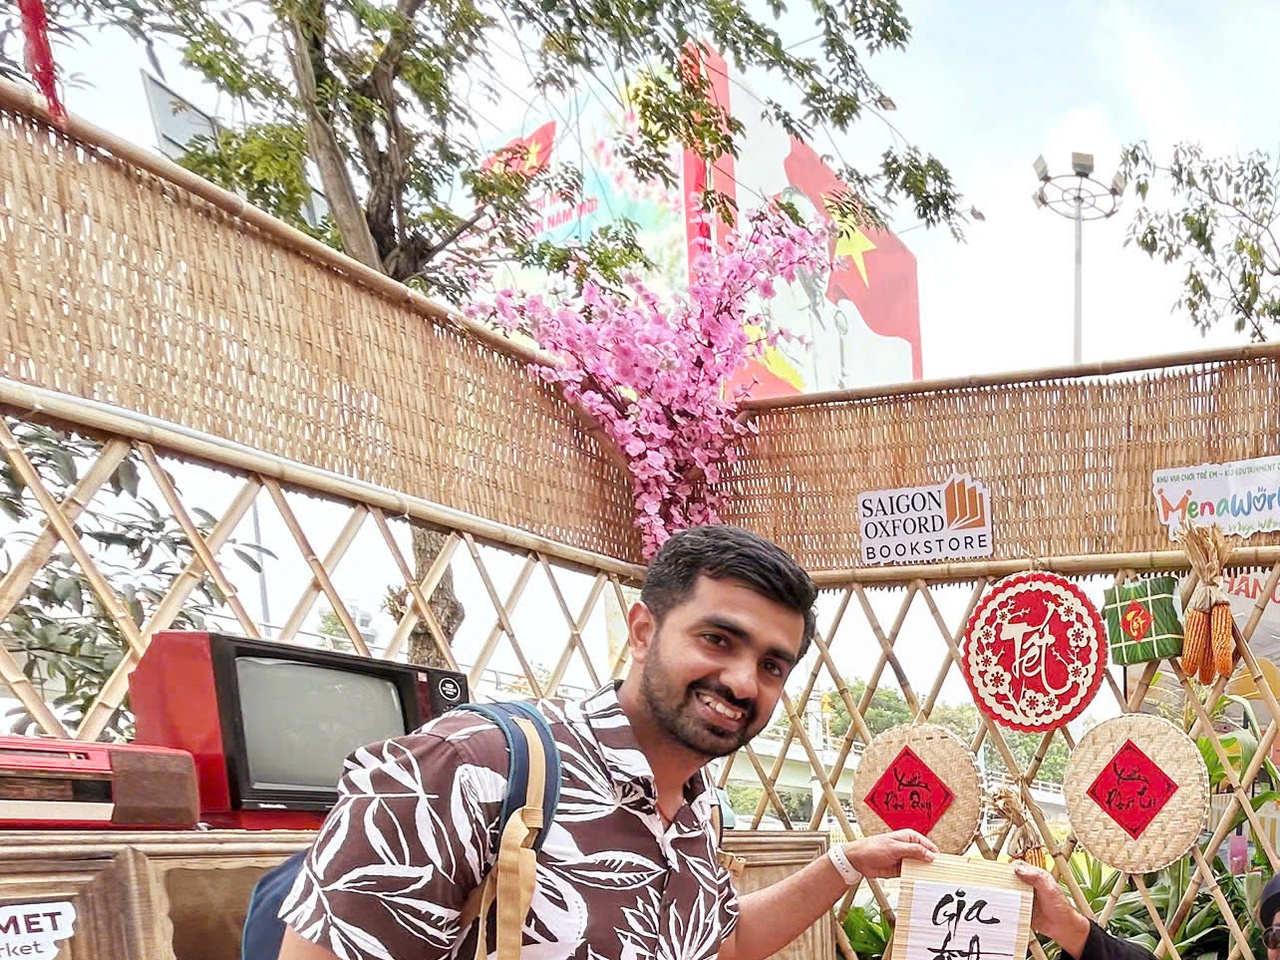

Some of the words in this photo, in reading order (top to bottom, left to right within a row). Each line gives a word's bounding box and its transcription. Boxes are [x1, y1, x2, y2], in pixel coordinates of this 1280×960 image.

[861, 489, 943, 518] SAIGON
[864, 514, 945, 540] OXFORD
[866, 533, 988, 560] BOOKSTORE
[1001, 601, 1072, 695] Tết
